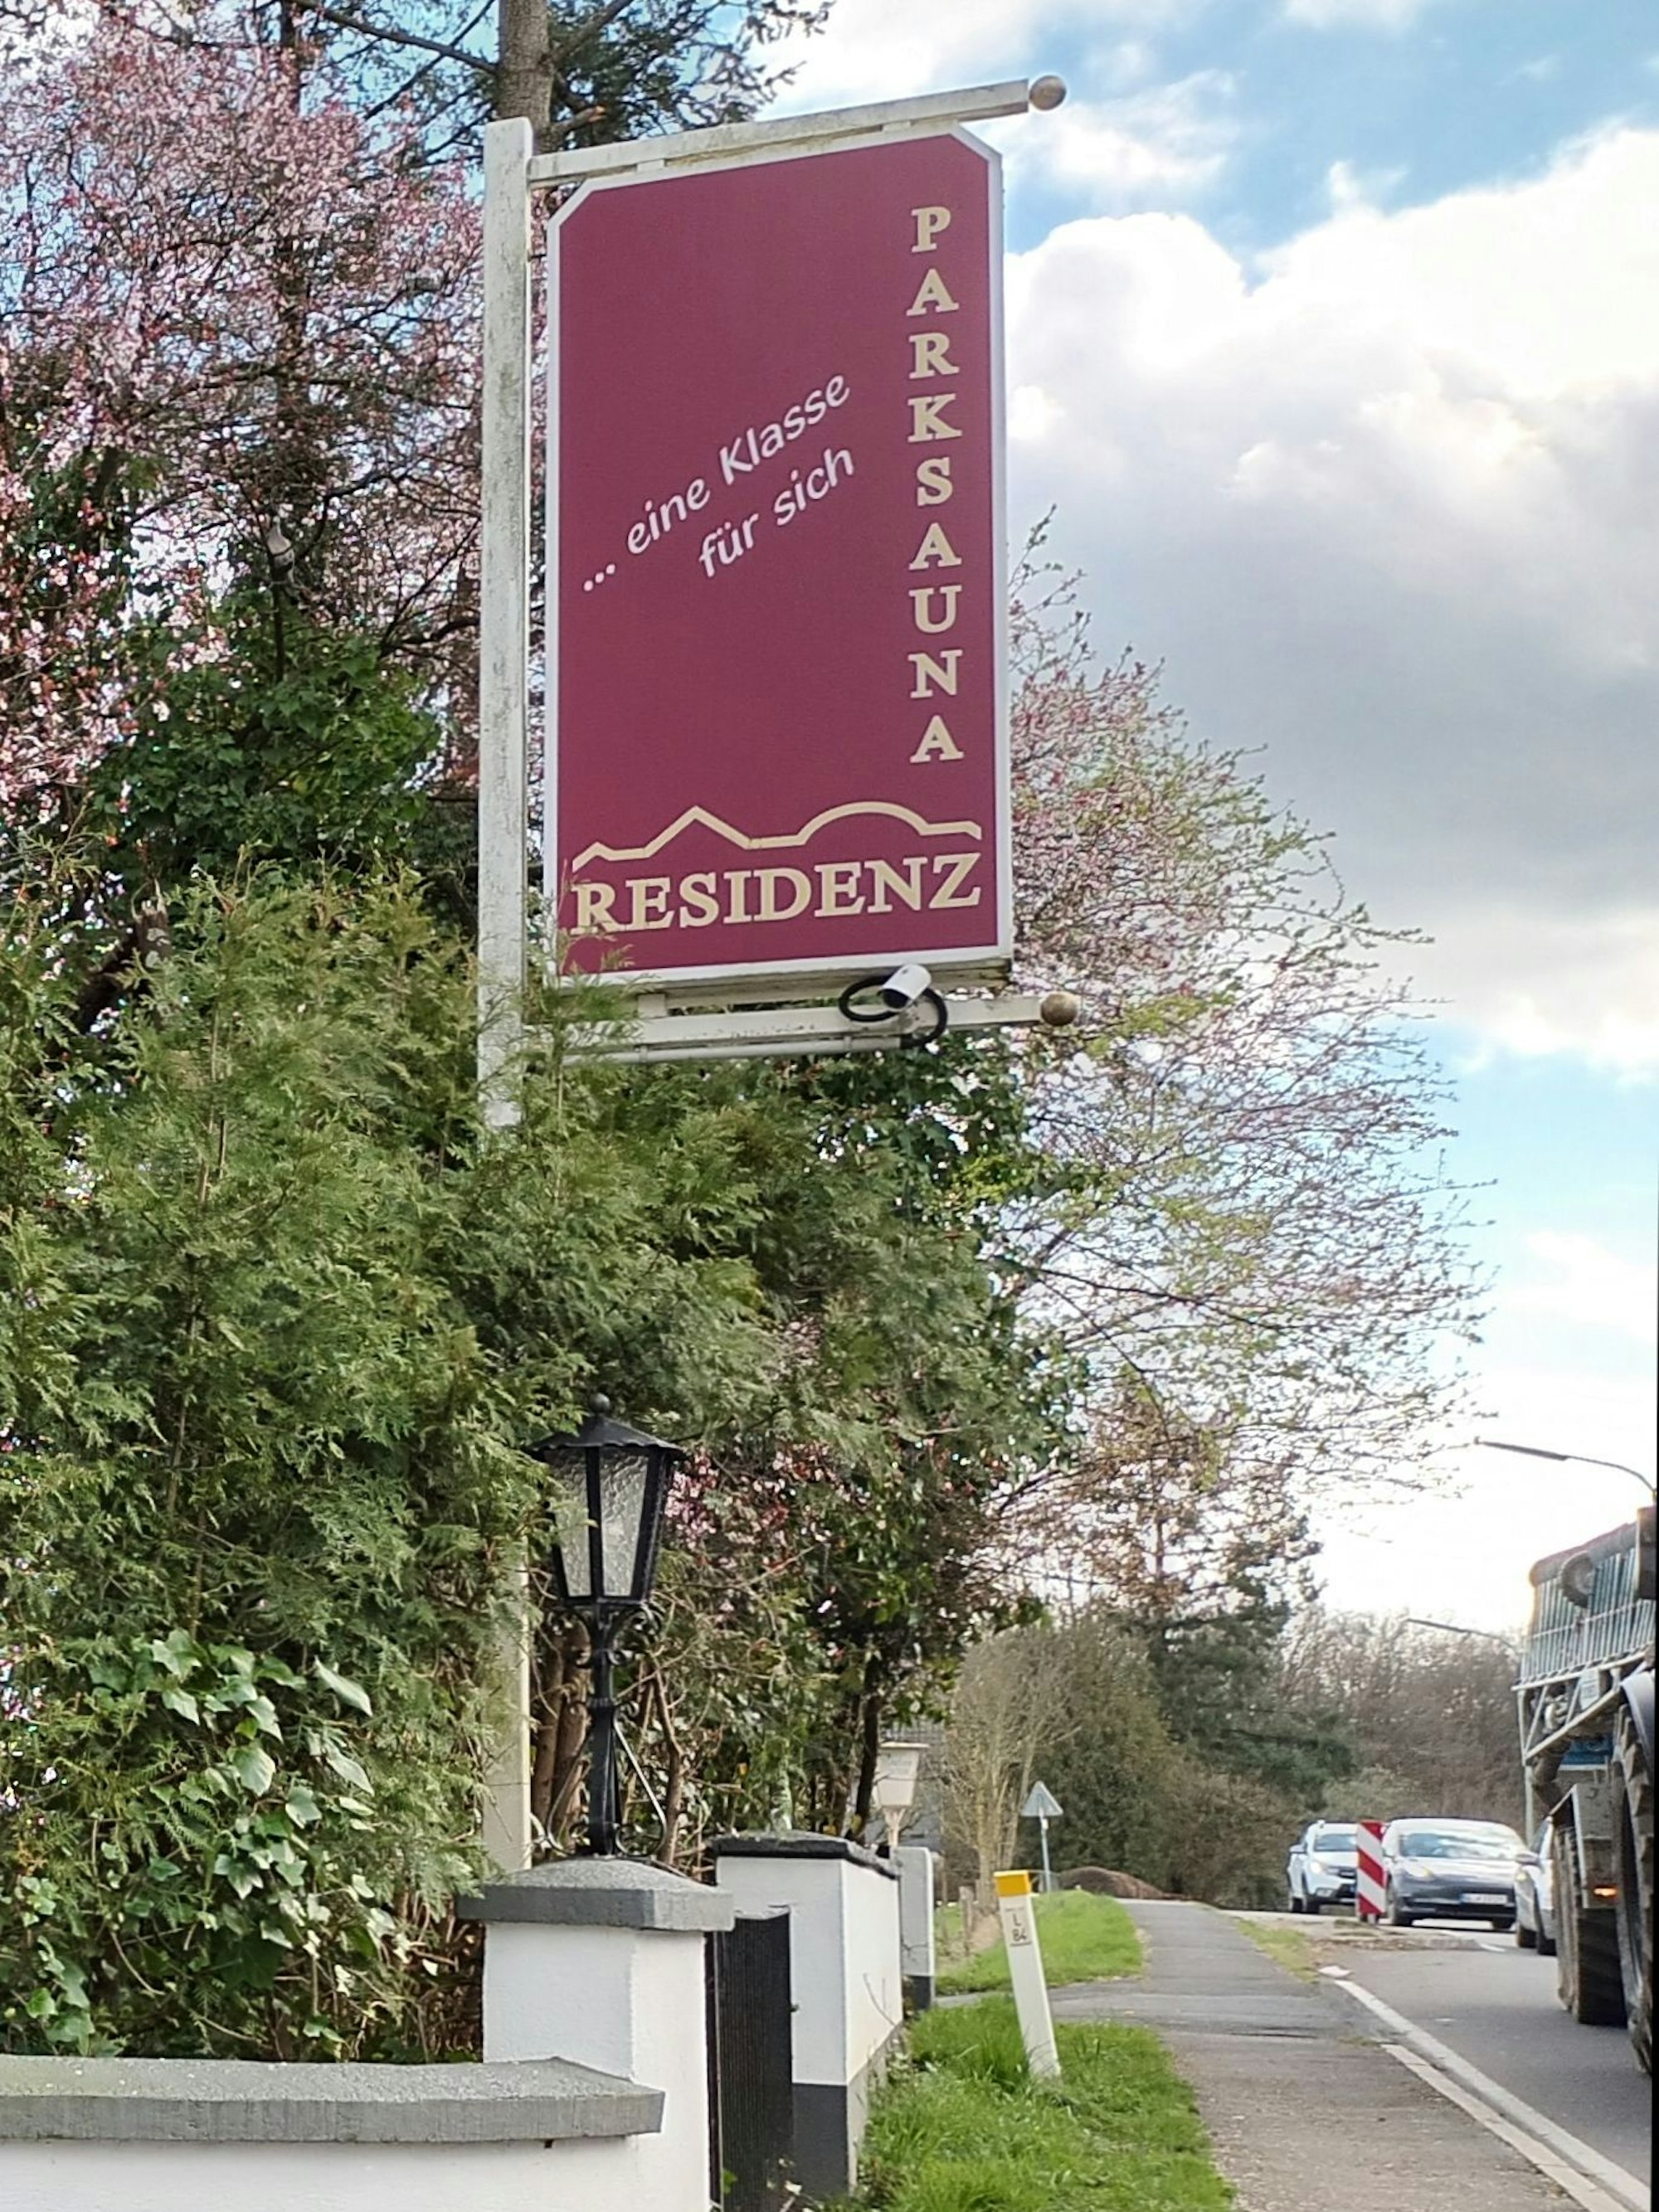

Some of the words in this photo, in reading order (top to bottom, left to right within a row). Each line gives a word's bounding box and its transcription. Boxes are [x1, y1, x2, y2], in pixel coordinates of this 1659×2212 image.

[627, 479, 711, 554] eine
[719, 375, 850, 485] Klasse
[698, 513, 759, 577] für
[774, 449, 854, 526] sich
[906, 206, 964, 763] PARKSAUNA
[569, 852, 981, 936] RESIDENZ
